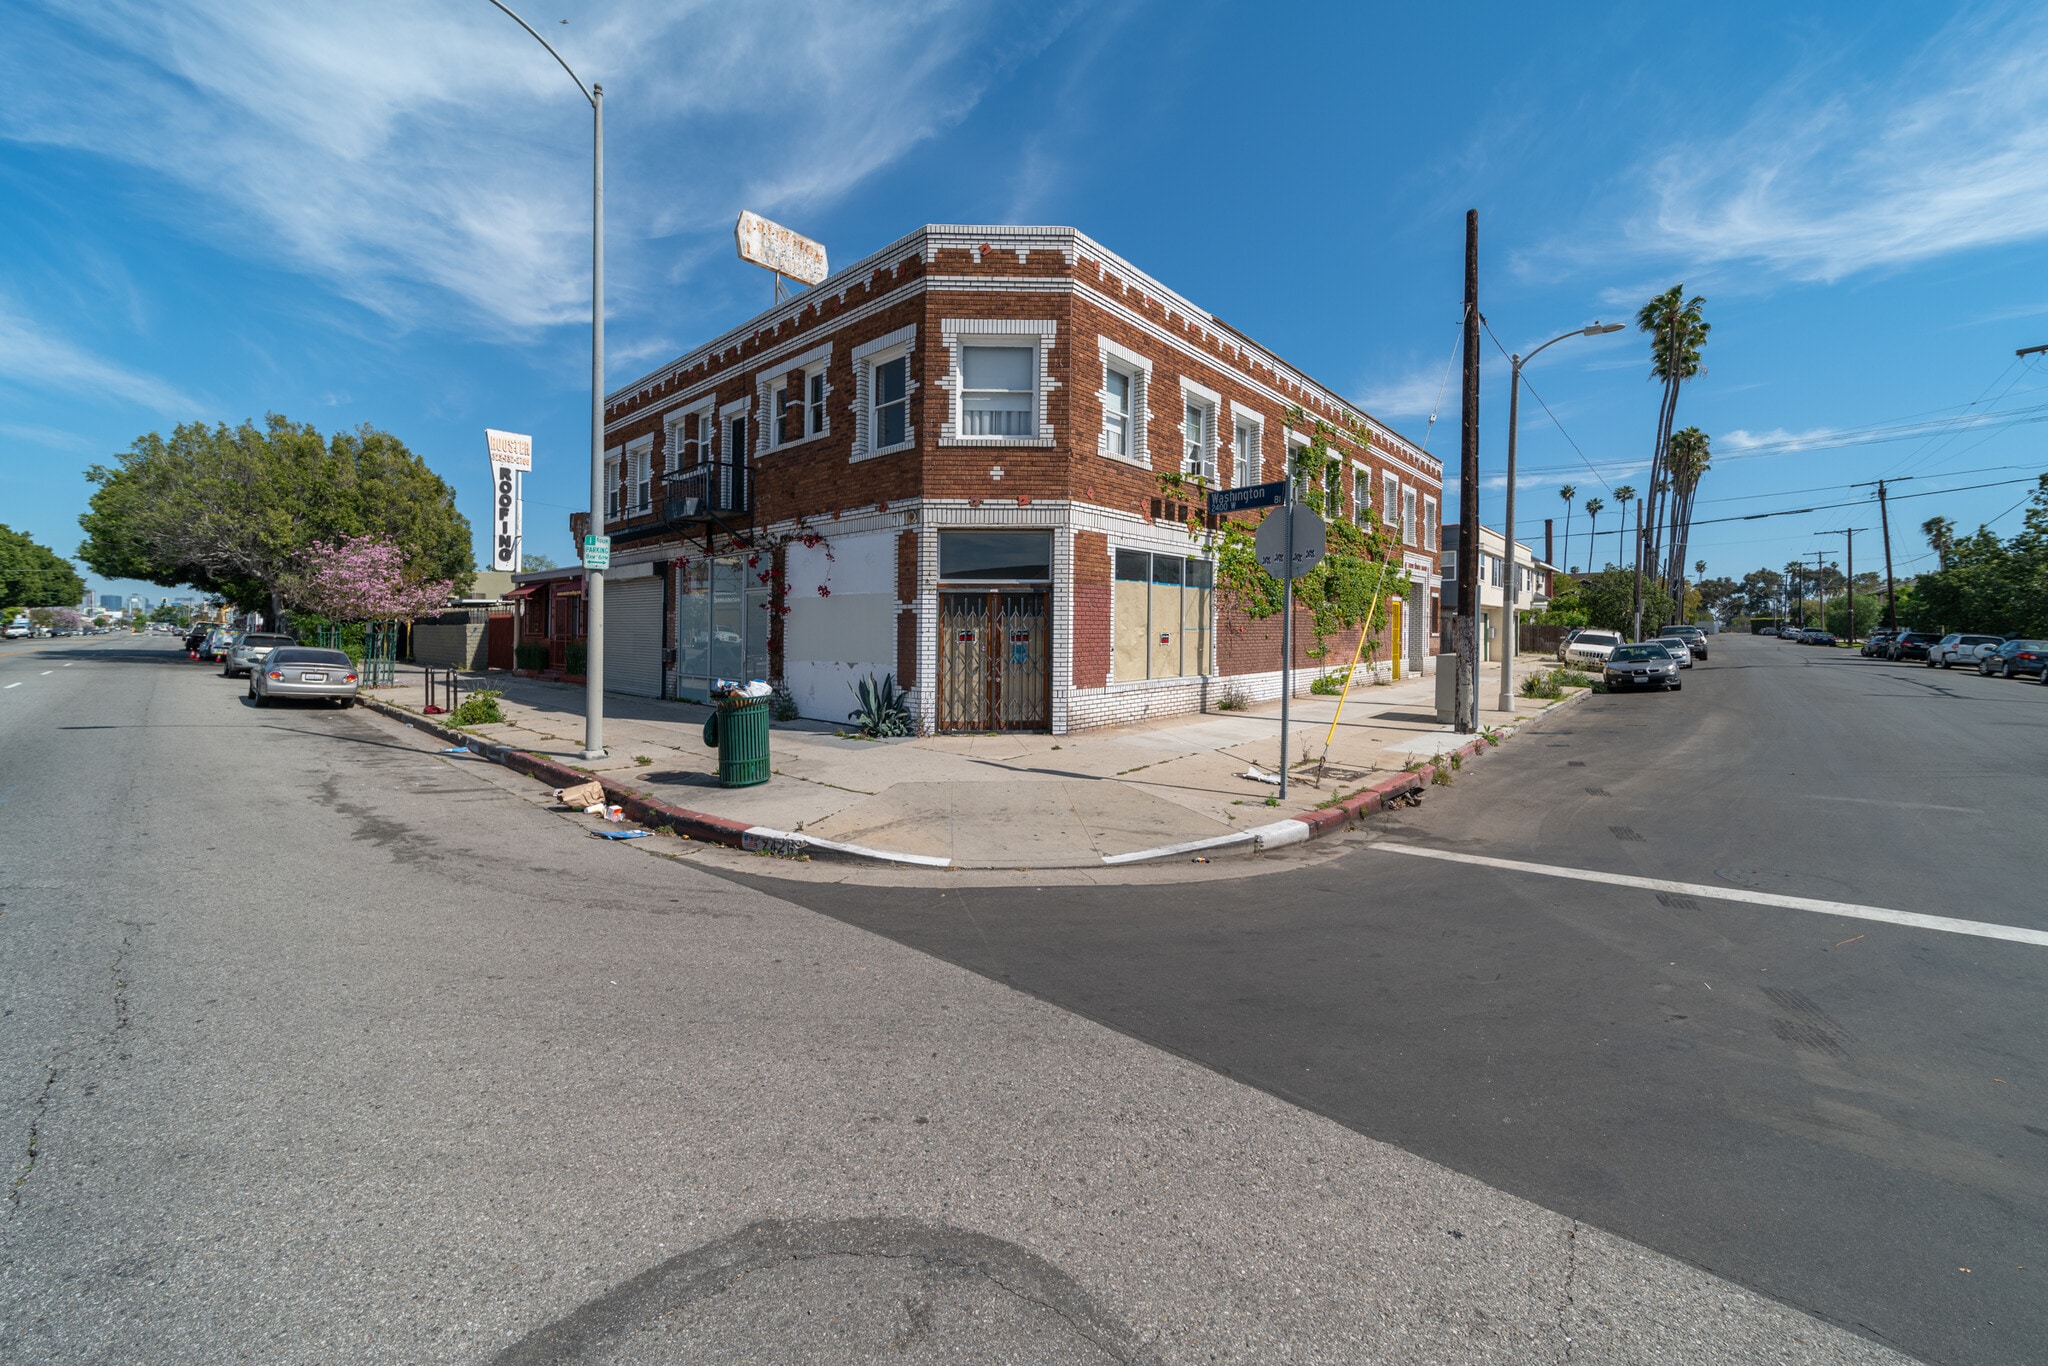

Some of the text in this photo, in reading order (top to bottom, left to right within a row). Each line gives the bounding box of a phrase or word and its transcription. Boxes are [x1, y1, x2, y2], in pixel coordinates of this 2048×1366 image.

[1211, 488, 1265, 504] Washington
[1211, 502, 1237, 512] 2400 W
[499, 467, 512, 562] ROOFING
[585, 546, 608, 554] PARKING
